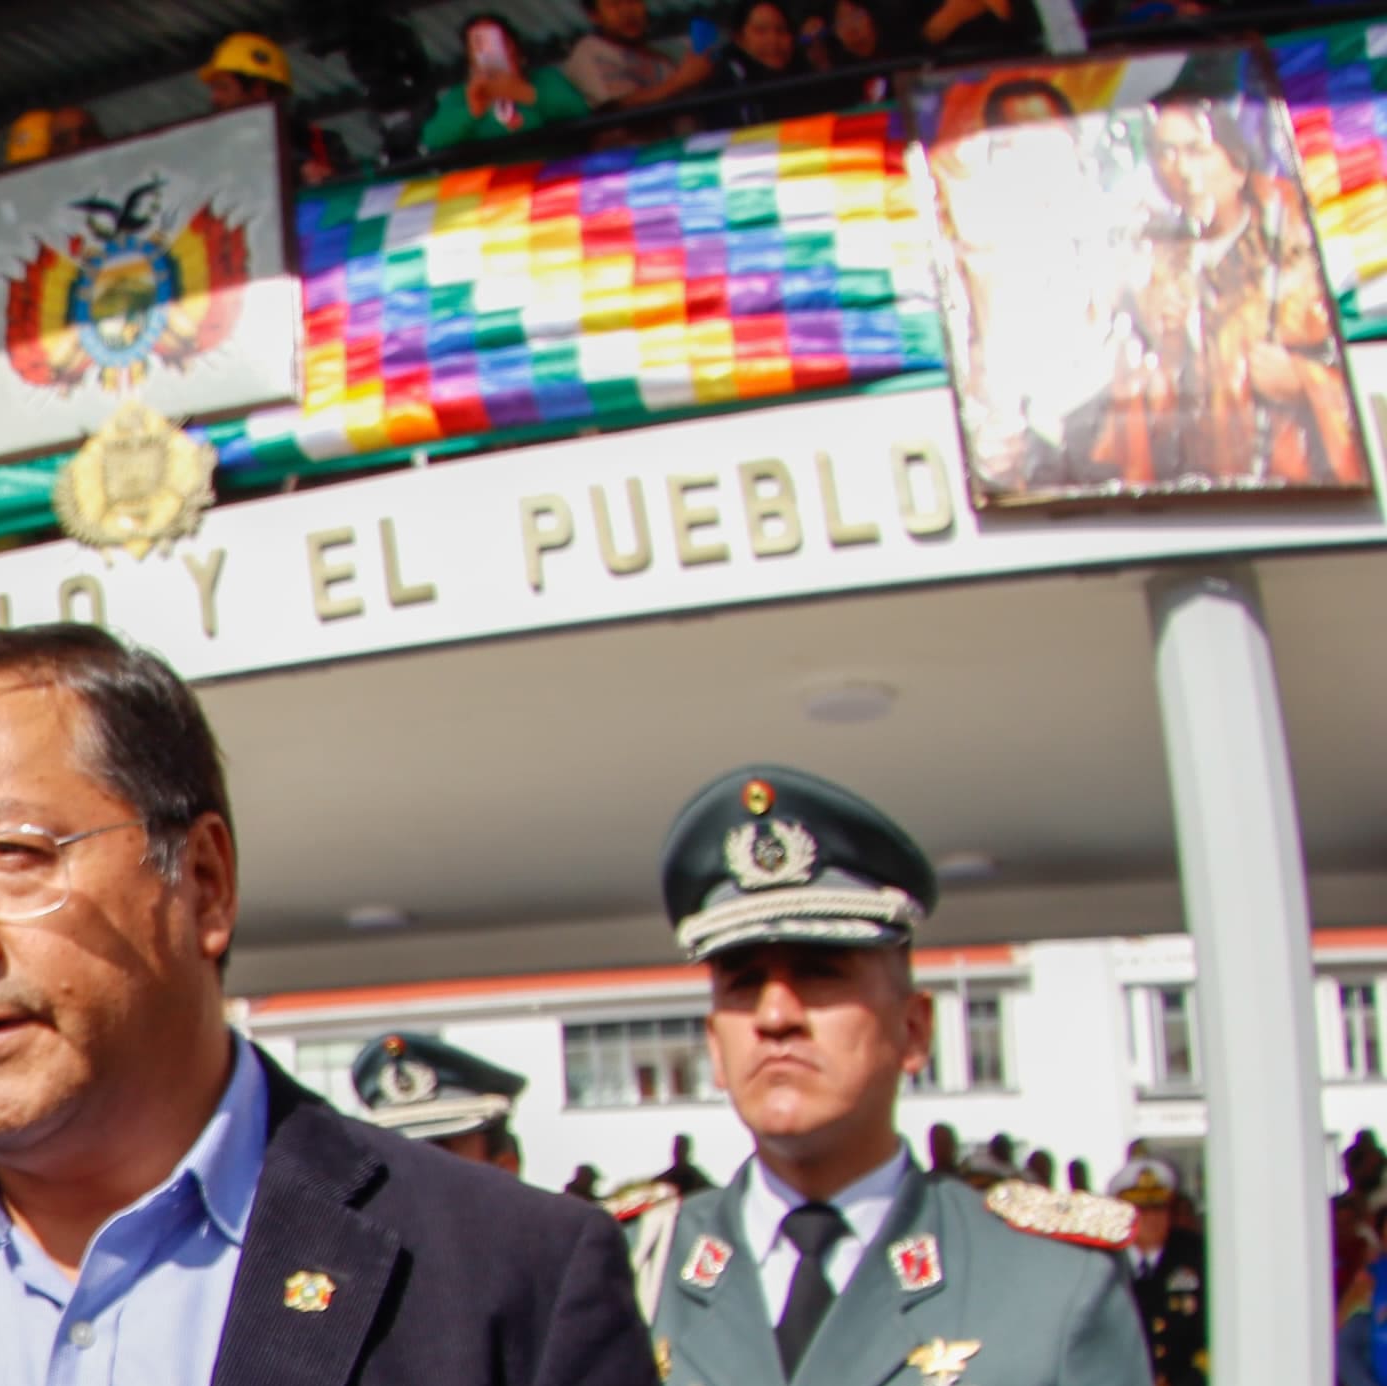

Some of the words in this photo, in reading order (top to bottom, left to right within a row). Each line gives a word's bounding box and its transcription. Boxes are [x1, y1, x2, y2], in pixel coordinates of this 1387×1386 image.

[182, 548, 227, 639] Y
[306, 516, 438, 624] EL
[519, 440, 957, 594] PUEBLO
